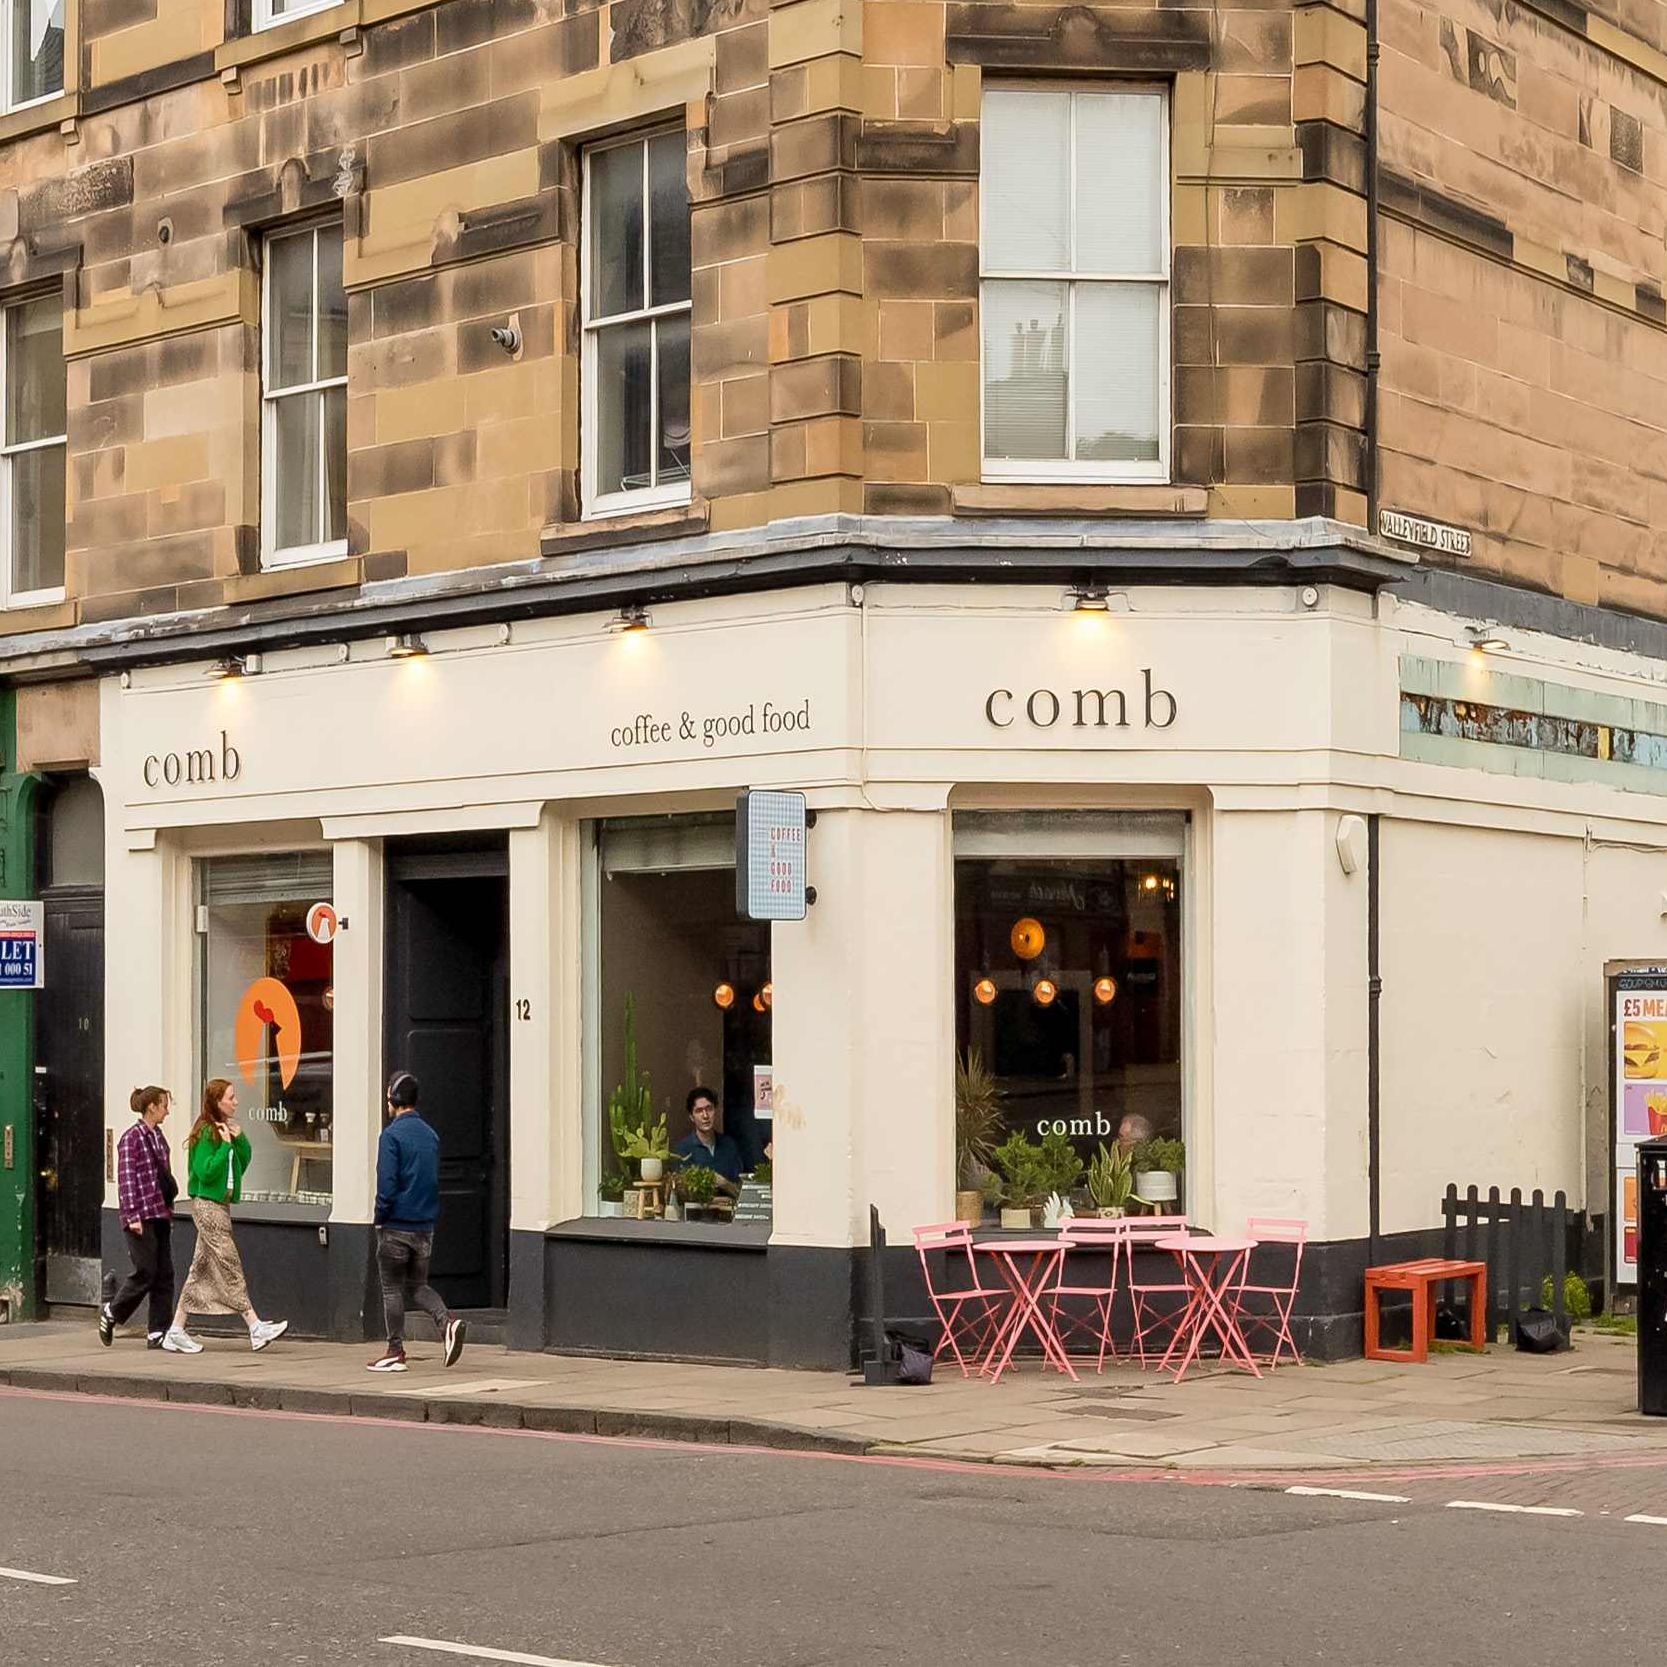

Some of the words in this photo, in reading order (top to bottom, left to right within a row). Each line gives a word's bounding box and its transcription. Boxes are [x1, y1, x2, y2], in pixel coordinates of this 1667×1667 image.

[1441, 528, 1470, 554] STREET
[985, 667, 1178, 729] comb
[611, 713, 672, 748] coffee
[678, 710, 697, 741] &
[702, 703, 756, 748] good
[762, 698, 812, 733] food
[143, 729, 241, 788] comb
[770, 827, 801, 842] COFFEE
[770, 861, 792, 876] GOOD
[770, 879, 792, 893] FOOD
[0, 940, 34, 961] LET
[4, 962, 22, 976] 000
[23, 962, 33, 976] 51
[515, 998, 531, 1021] 12
[1624, 998, 1641, 1017] £5
[78, 1017, 90, 1031] 10
[248, 1100, 288, 1122] comb
[1037, 1110, 1111, 1136] comb
